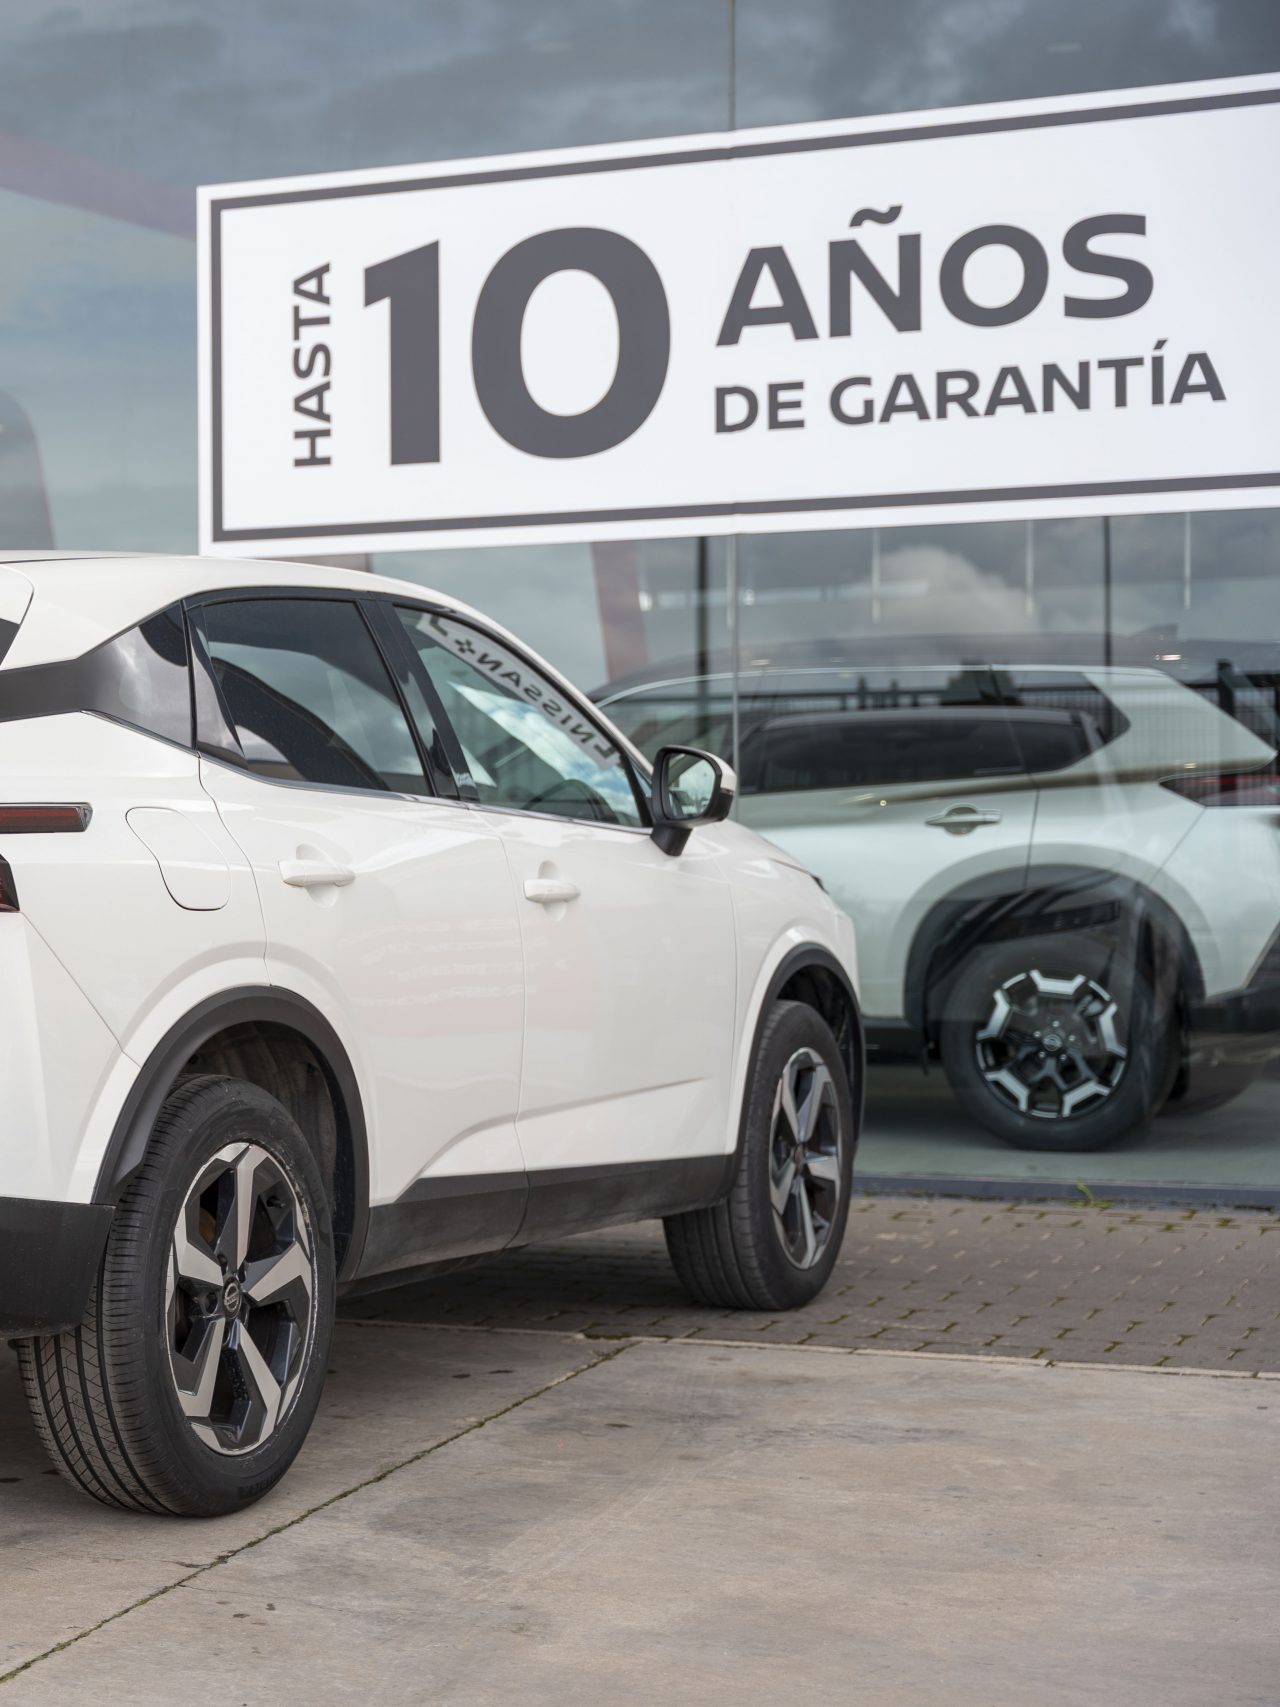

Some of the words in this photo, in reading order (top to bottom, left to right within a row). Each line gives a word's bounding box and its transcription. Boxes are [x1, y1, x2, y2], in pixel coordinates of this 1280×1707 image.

[293, 262, 332, 467] HASTA
[365, 227, 671, 466] 10
[716, 205, 1154, 346] AÑOS
[716, 382, 805, 434] DE
[829, 338, 1227, 425] GARANTÍA
